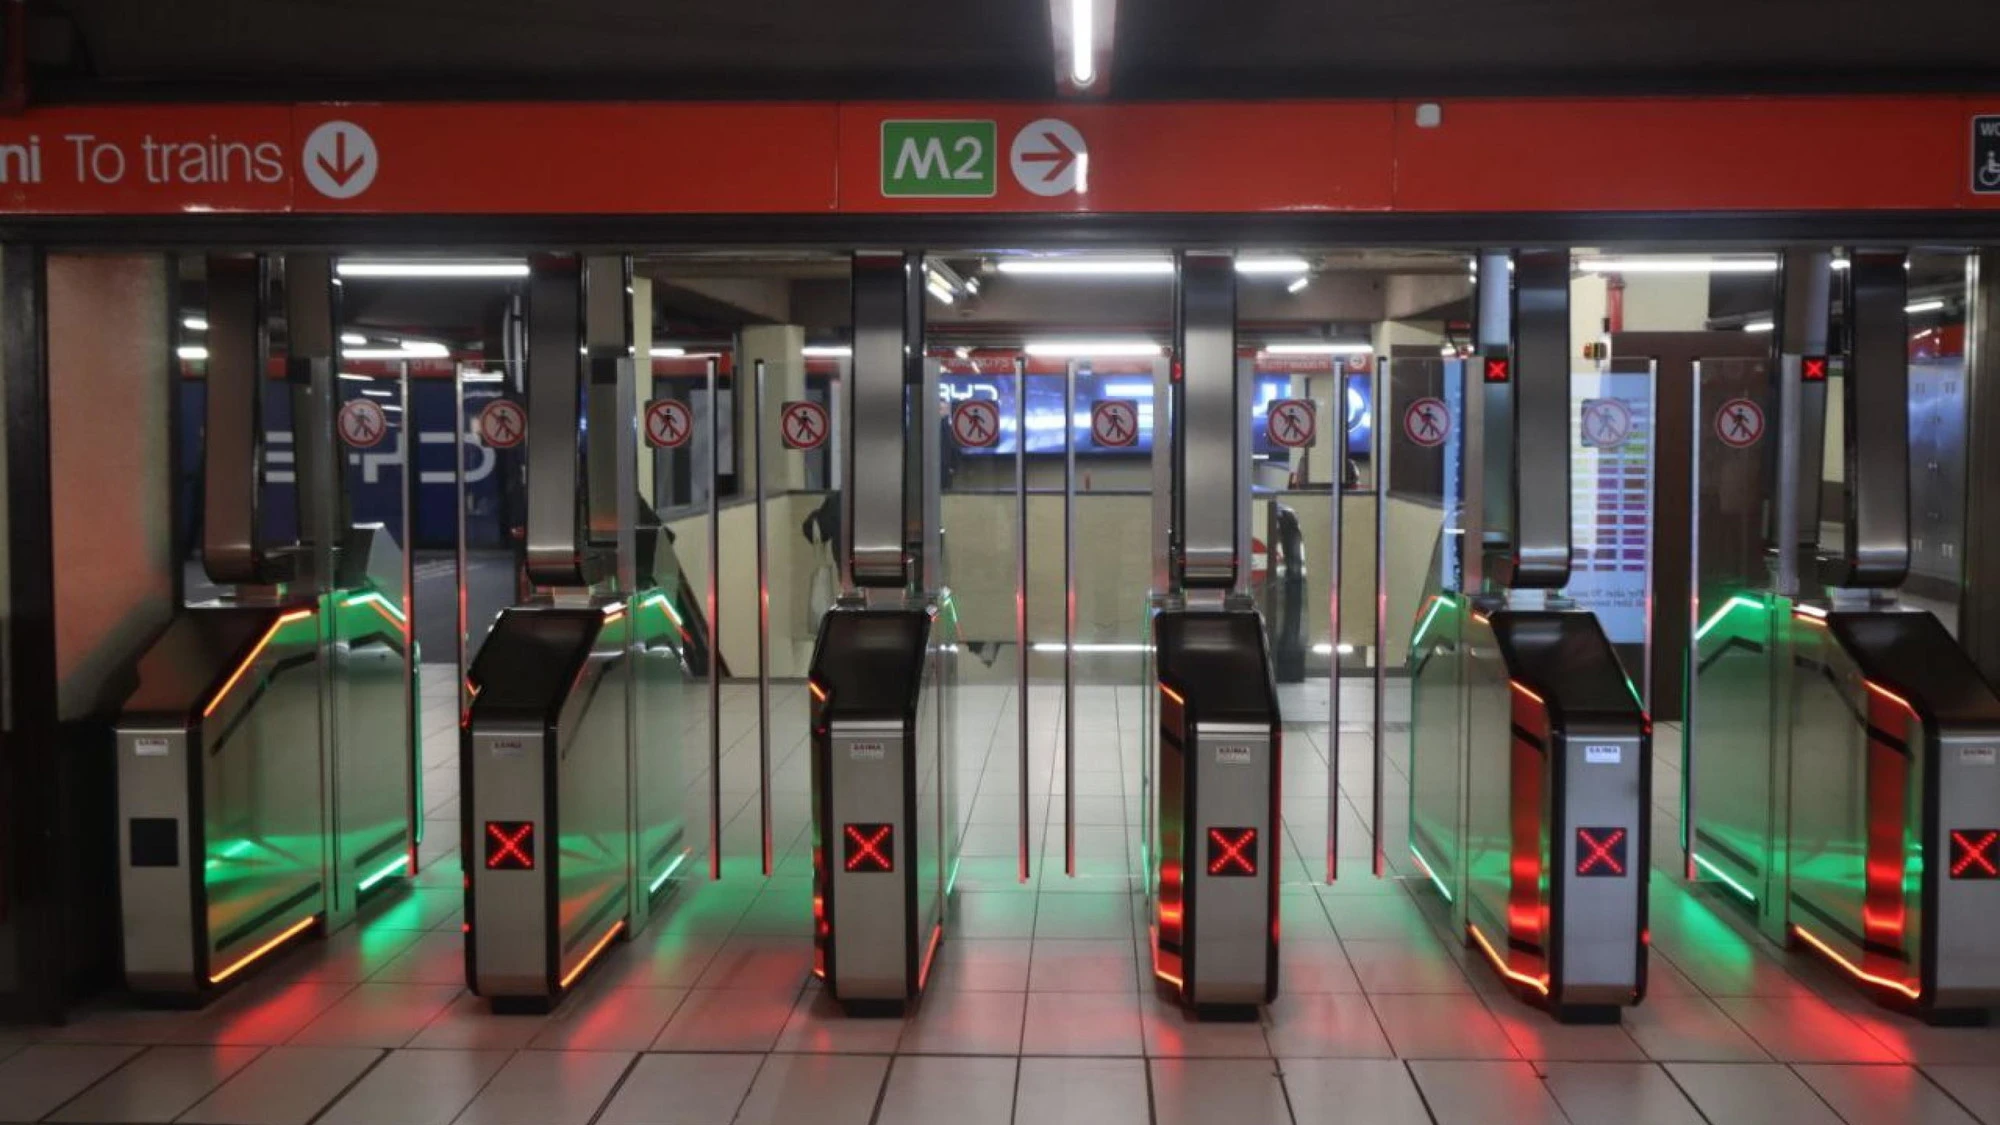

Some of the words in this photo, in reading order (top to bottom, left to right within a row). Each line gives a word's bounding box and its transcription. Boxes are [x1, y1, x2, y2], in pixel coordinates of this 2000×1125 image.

[0, 135, 42, 183] ni
[64, 134, 126, 184] To
[141, 134, 284, 184] trains
[893, 136, 984, 180] M2
